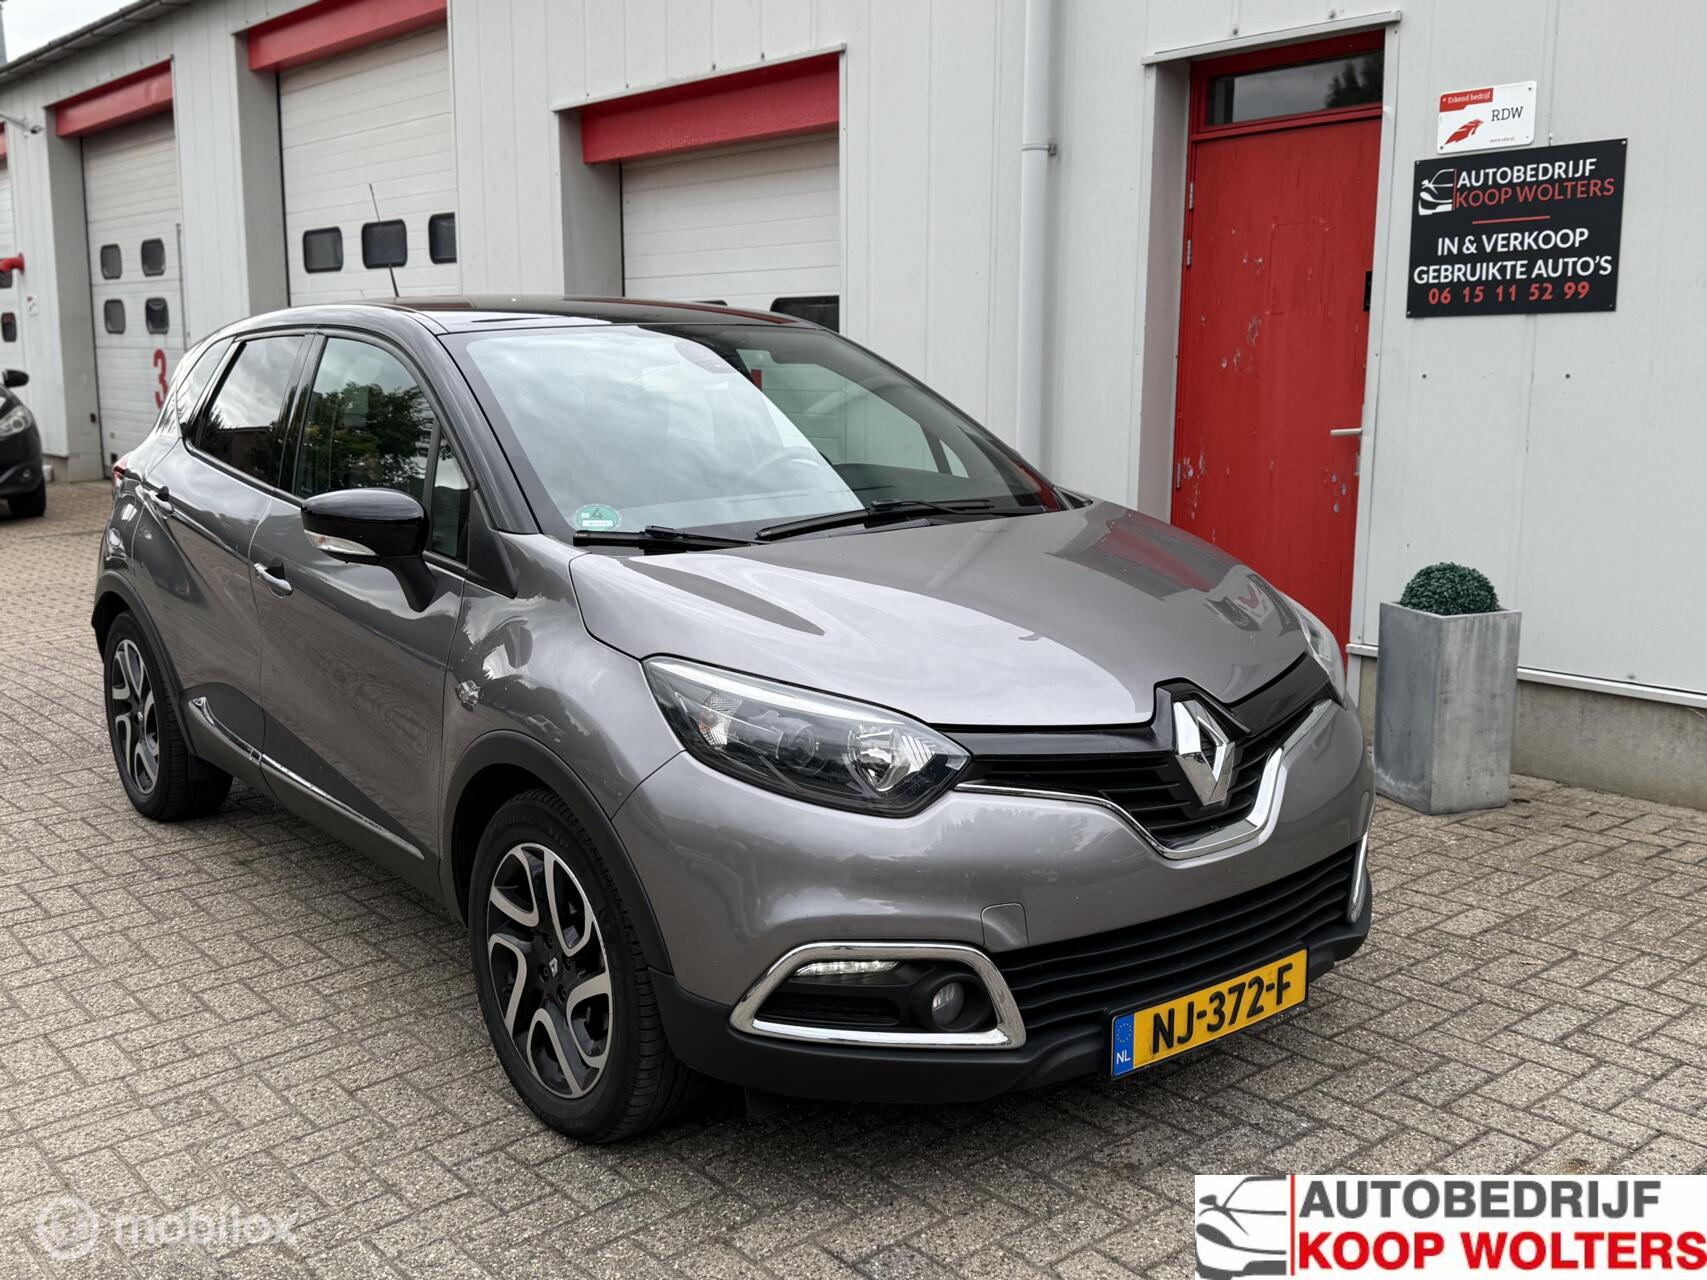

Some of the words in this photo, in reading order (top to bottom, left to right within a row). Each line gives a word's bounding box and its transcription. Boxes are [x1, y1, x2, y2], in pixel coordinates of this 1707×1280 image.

[1471, 91, 1491, 101] bedrijf
[1491, 106, 1524, 121] RDW
[1457, 158, 1597, 188] AUTOBEDRIJF
[1456, 187, 1512, 208] KOOP
[1517, 178, 1615, 203] WOLTERS
[1437, 236, 1458, 256] IN
[1462, 235, 1477, 254] &
[1482, 228, 1589, 252] VERKOOP
[1413, 259, 1528, 284] GEBRUIKTE
[1531, 255, 1612, 279] AUTO'S
[1428, 288, 1451, 304] 06
[1463, 286, 1485, 303] 15
[1496, 284, 1517, 302] 11
[1529, 283, 1553, 300] 52
[1563, 281, 1590, 299] 99
[153, 348, 168, 410] 3
[1152, 963, 1293, 1054] NJ-372-F
[1116, 1051, 1131, 1065] NL
